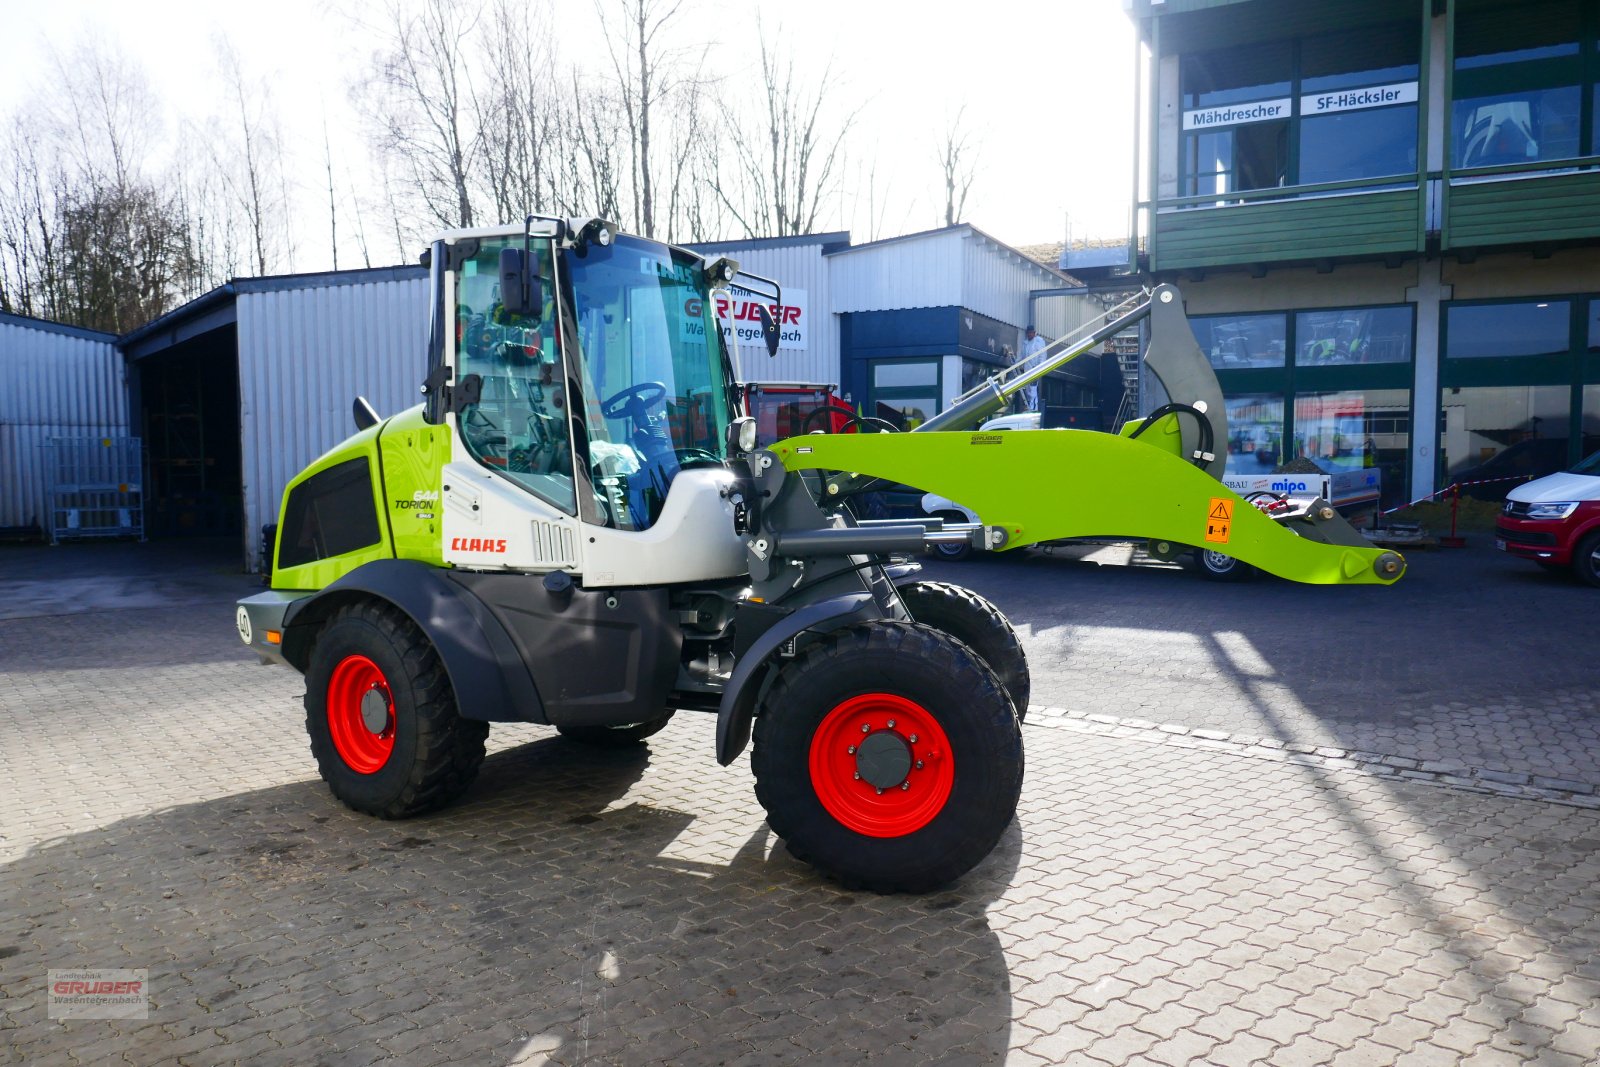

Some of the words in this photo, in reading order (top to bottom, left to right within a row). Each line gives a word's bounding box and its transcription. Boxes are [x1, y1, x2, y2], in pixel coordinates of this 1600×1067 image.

[1317, 89, 1401, 110] SF-Häcksler
[1193, 104, 1282, 126] Mähdrescher
[1271, 478, 1307, 495] mipa
[413, 489, 440, 502] 644
[395, 500, 434, 510] TORION
[451, 537, 507, 553] CLAAS
